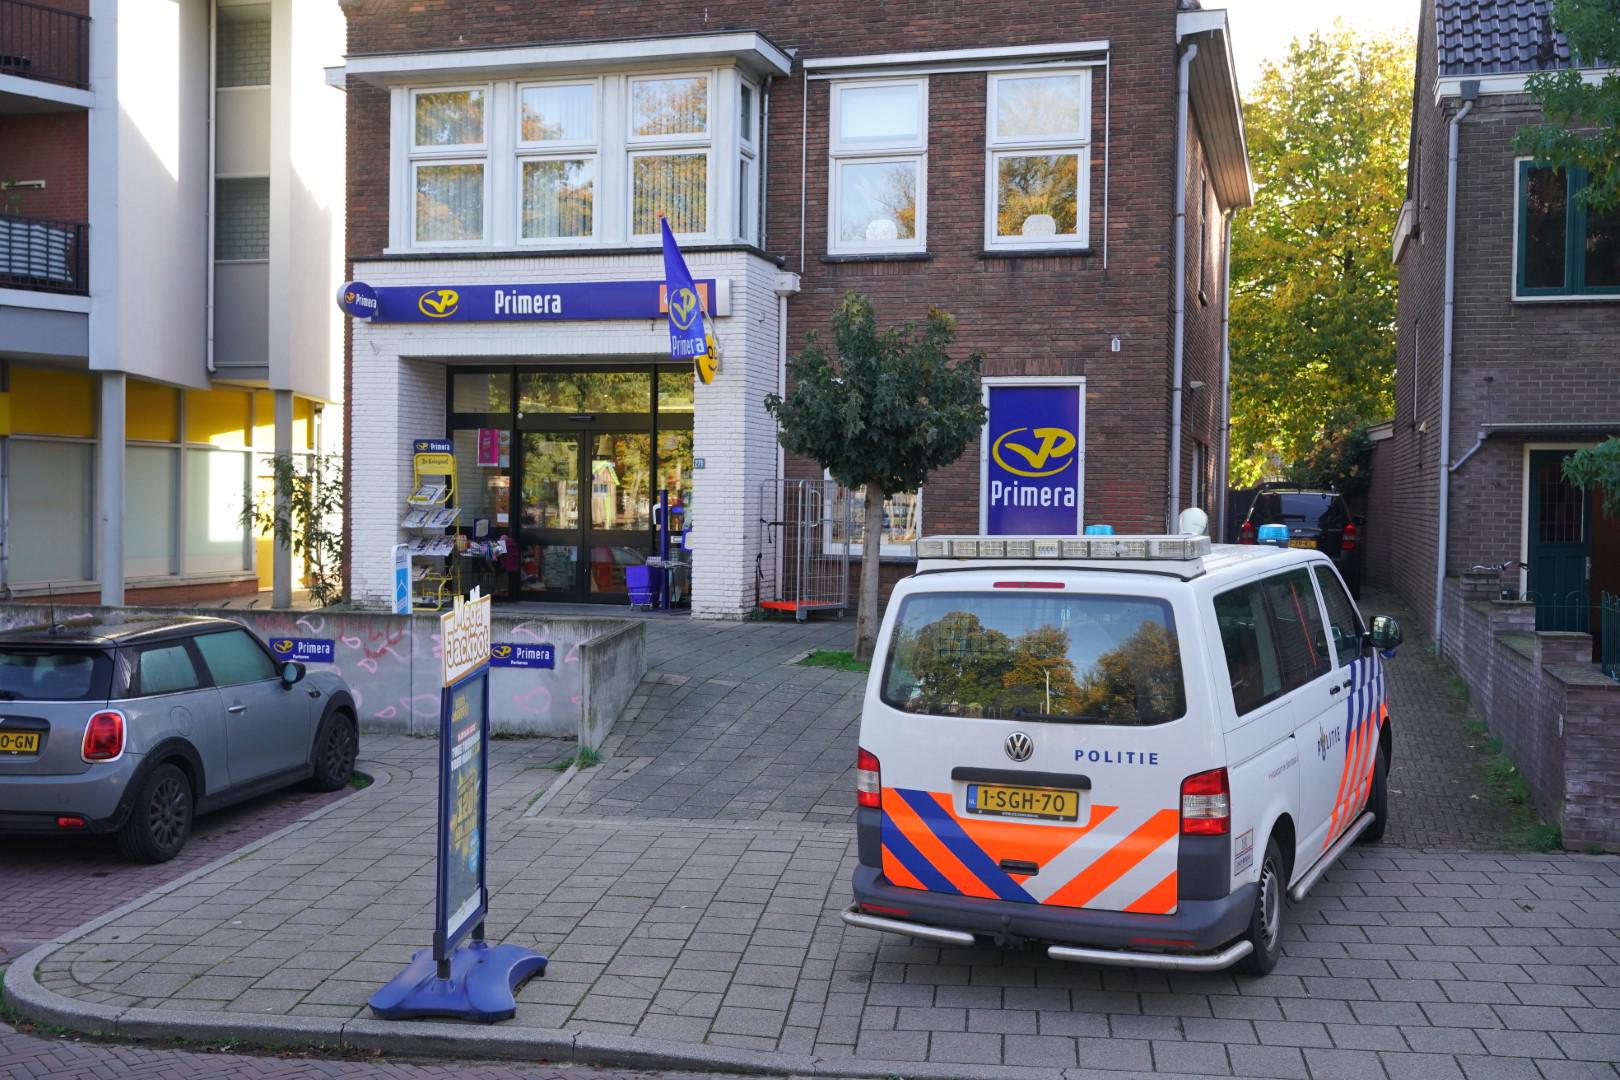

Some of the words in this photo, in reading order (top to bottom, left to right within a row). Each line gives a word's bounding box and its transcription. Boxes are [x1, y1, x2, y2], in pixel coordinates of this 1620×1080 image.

[355, 293, 377, 309] Primera
[494, 289, 562, 315] Primera
[671, 335, 705, 356] Primera
[430, 442, 450, 451] Primera
[991, 480, 1075, 507] Primera
[453, 595, 483, 632] Mega
[298, 641, 331, 654] Primera
[447, 625, 489, 668] Jackpot
[516, 647, 550, 660] Primera
[1074, 749, 1158, 765] POLITIE
[983, 789, 1065, 813] 1-SGH-70
